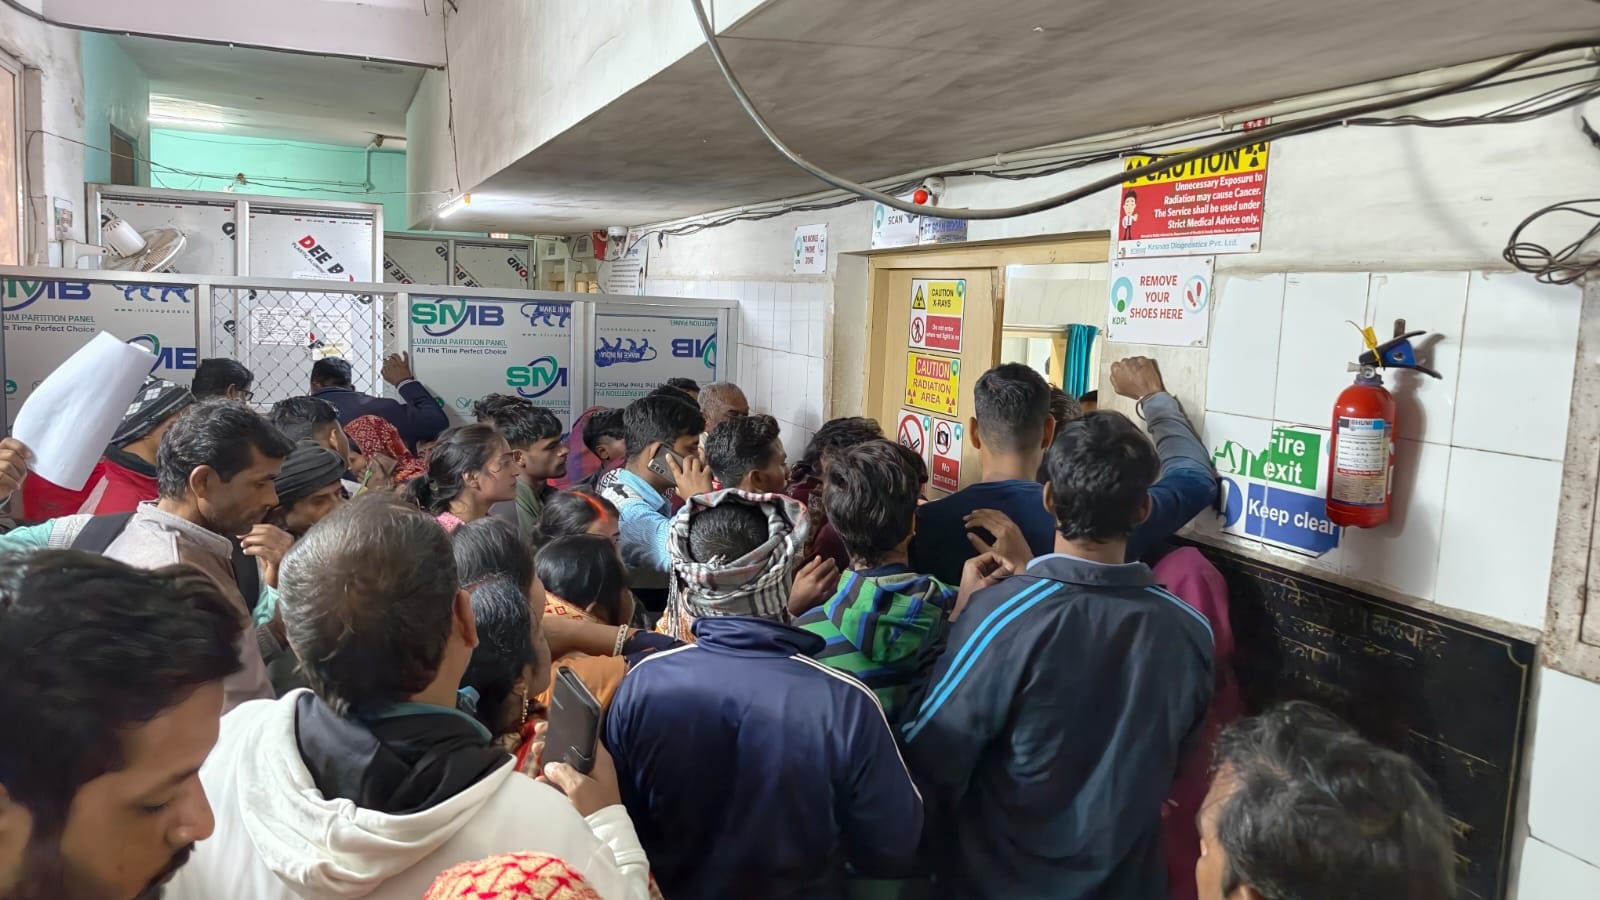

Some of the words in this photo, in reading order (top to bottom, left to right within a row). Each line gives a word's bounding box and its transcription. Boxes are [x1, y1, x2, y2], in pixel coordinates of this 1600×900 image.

[1175, 178, 1220, 192] Unnecessary
[1220, 176, 1254, 188] Exposure
[1254, 173, 1263, 182] to
[1164, 193, 1195, 205] Radiation
[1196, 193, 1212, 203] may
[1212, 191, 1233, 200] cause
[1234, 187, 1261, 198] Cancer.
[1154, 208, 1166, 218] The
[1167, 206, 1191, 217] Service
[1192, 204, 1209, 214] shall
[1210, 202, 1219, 213] be
[1220, 201, 1237, 211] used
[1238, 199, 1260, 210] under
[887, 214, 904, 225] SCAN
[1168, 219, 1186, 230] Strict
[1187, 216, 1214, 227] Medical
[1215, 214, 1241, 226] Advice
[1241, 213, 1260, 225] only.
[298, 234, 333, 265] DEE
[1170, 240, 1207, 250] Diagnostics
[1140, 275, 1179, 287] REMOVE
[931, 288, 954, 298] CAUTION
[1145, 292, 1170, 303] YOUR
[932, 299, 952, 308] X-RAYS
[21, 313, 66, 322] PARTITION
[411, 299, 505, 333] SMB
[1112, 317, 1127, 325] KDPL
[1130, 308, 1158, 319] SHOES
[1159, 309, 1183, 320] HERE
[66, 325, 95, 333] Choice
[915, 359, 950, 378] CAUTION
[913, 378, 952, 395] RADIATION
[920, 391, 942, 405] AREA
[1271, 430, 1307, 458] Fire
[940, 462, 951, 473] No
[1262, 460, 1304, 485] exit
[1247, 498, 1290, 526] Keep
[1293, 511, 1337, 535] clear
